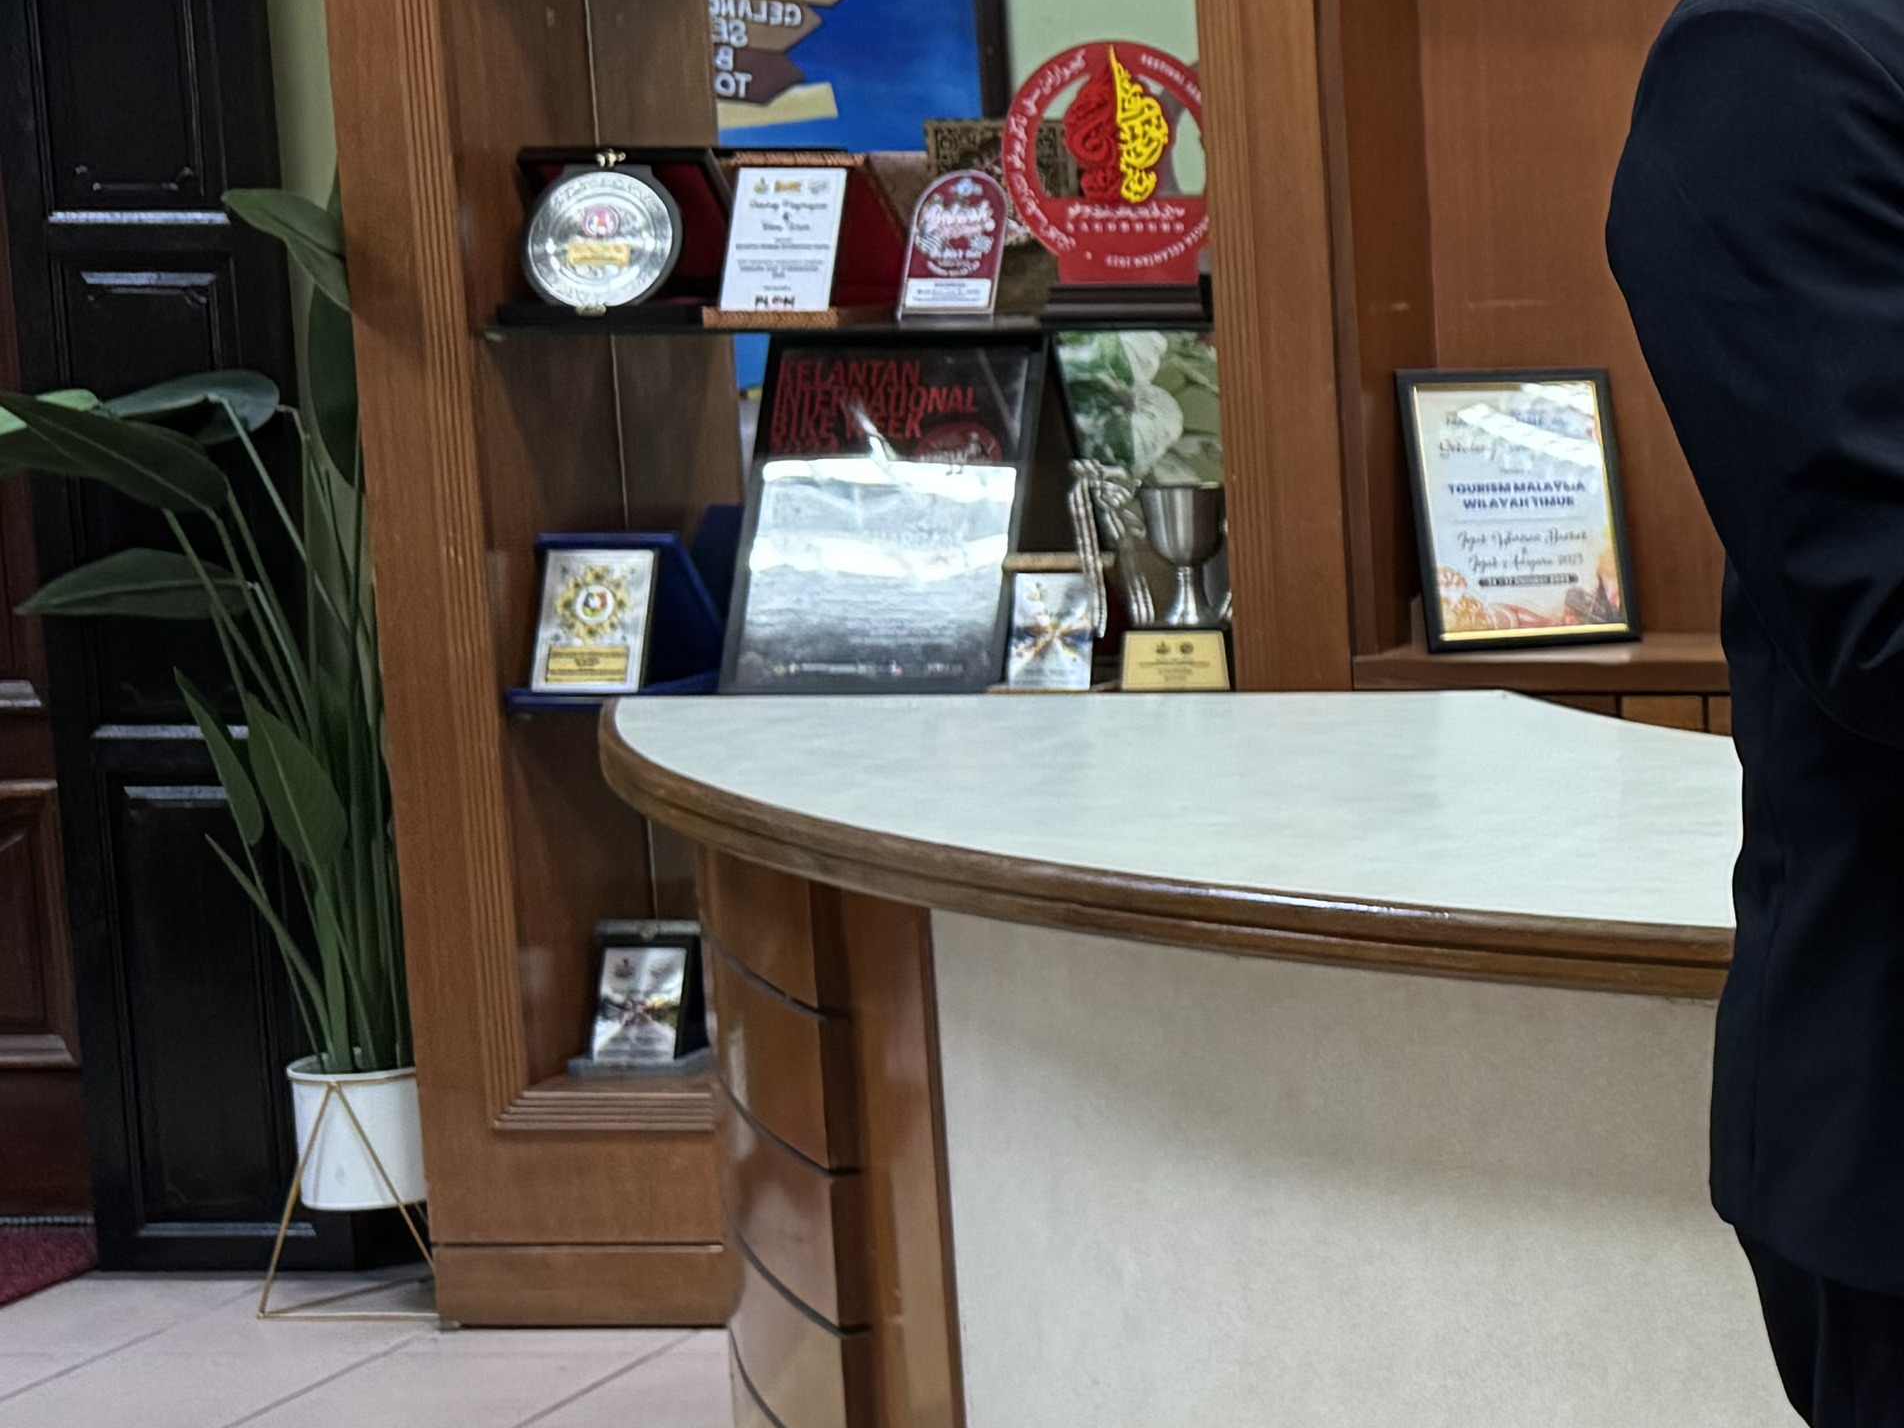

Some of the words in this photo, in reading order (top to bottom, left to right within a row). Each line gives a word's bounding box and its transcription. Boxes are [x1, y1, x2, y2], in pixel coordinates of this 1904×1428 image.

[779, 358, 922, 388] KELANTAN
[774, 384, 979, 415] INTERNATIONAL
[1447, 481, 1512, 496] TOURISM
[1462, 496, 1530, 510] WILAYAH
[1530, 495, 1576, 509] TIMUR
